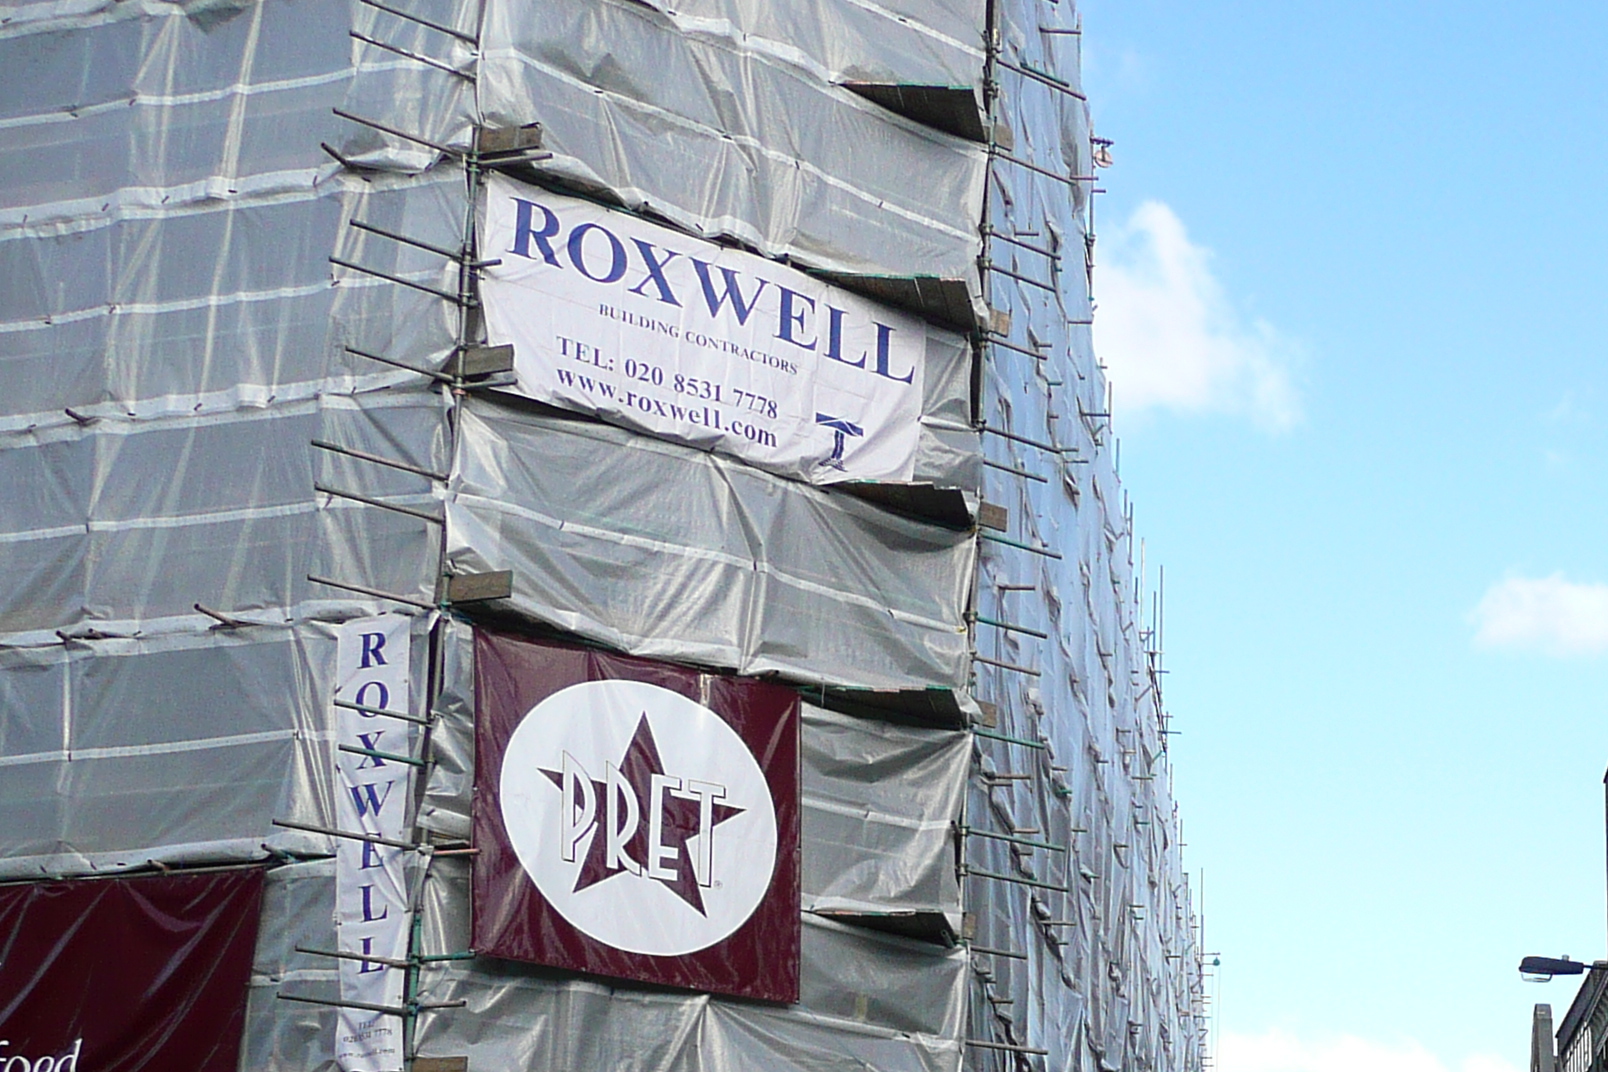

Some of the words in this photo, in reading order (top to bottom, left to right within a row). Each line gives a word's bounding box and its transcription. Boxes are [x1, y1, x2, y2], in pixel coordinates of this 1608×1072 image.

[507, 197, 915, 385] ROXWELL
[599, 303, 680, 339] BUILDING
[686, 330, 798, 375] CONTRACTORS
[556, 336, 614, 371] TEL:
[625, 358, 663, 387] 020
[673, 373, 723, 402] 8531
[733, 388, 778, 420] 7778
[556, 368, 777, 448] www.roxwell.com
[348, 632, 395, 974] ROXWELL
[561, 750, 726, 888] PRET
